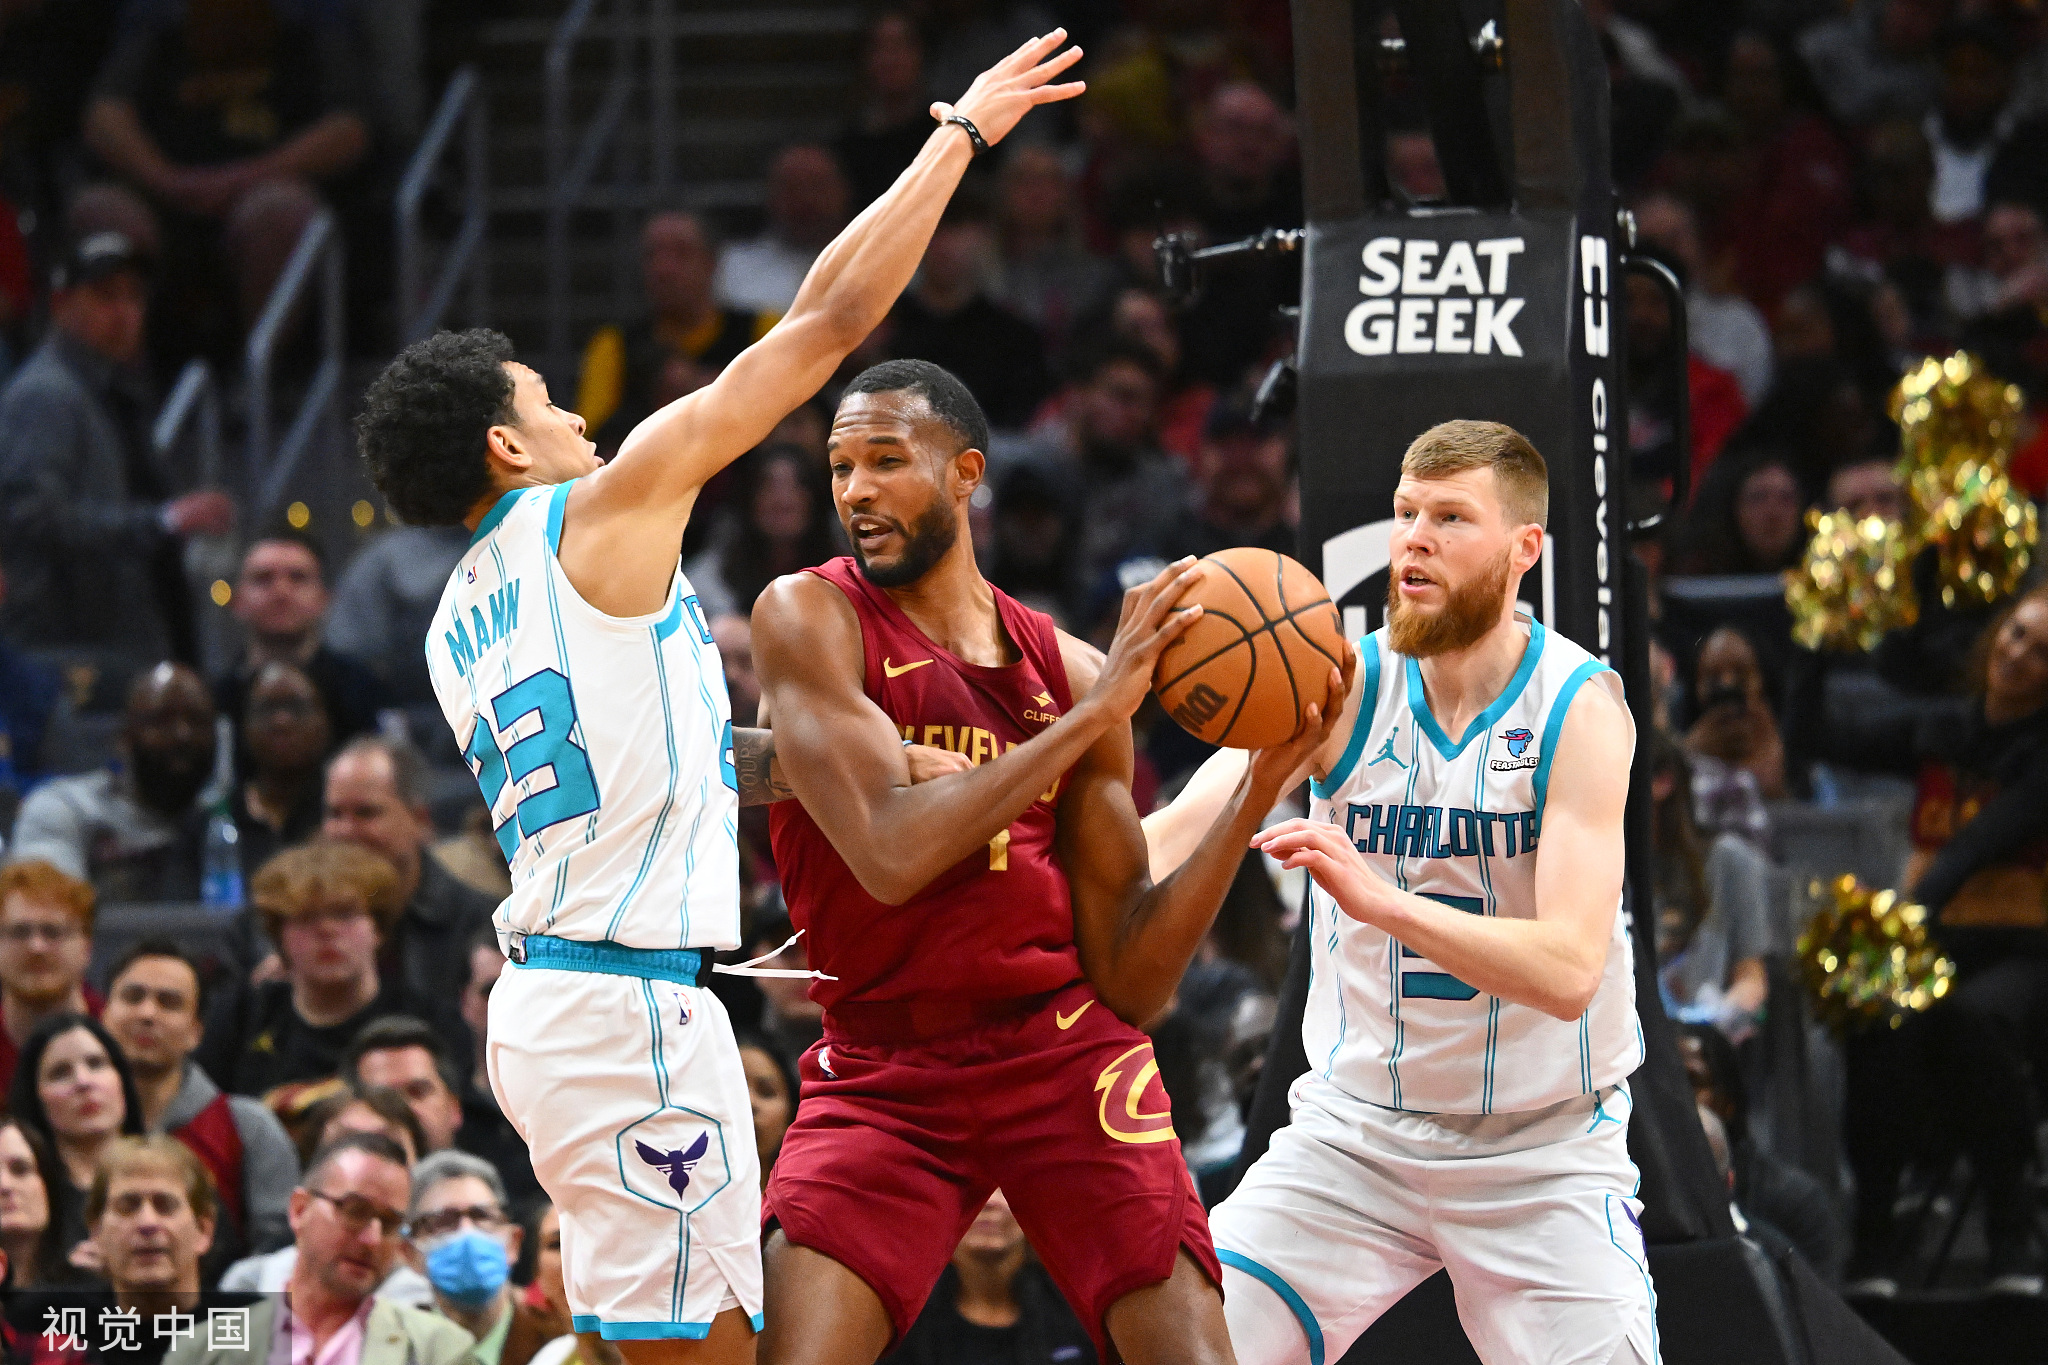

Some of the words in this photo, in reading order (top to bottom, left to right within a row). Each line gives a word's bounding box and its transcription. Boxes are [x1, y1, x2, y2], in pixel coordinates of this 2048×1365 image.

[1360, 237, 1525, 297] SEAT
[1344, 298, 1525, 358] GEEK
[444, 577, 520, 678] MANN
